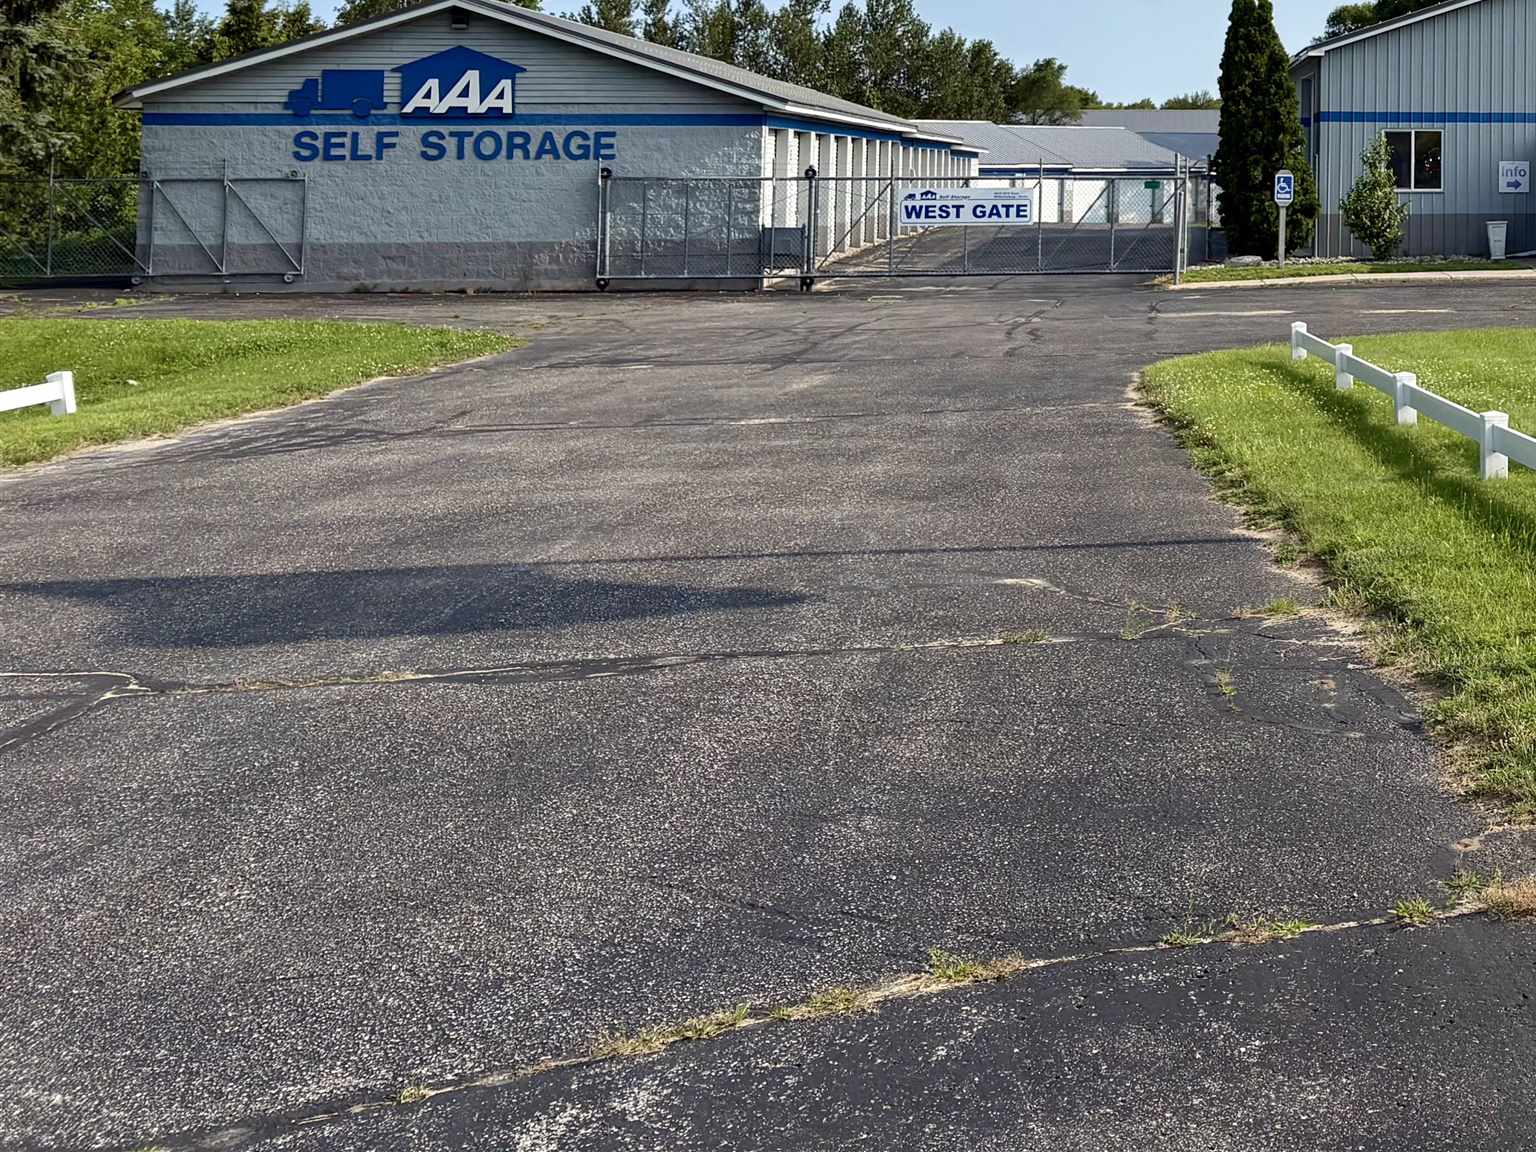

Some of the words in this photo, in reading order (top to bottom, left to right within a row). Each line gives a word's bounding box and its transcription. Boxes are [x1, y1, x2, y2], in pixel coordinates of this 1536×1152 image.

[401, 69, 513, 114] AAA
[292, 130, 400, 162] SELF
[419, 130, 617, 162] STORAGE
[904, 204, 965, 219] WEST
[972, 204, 1028, 219] GATE
